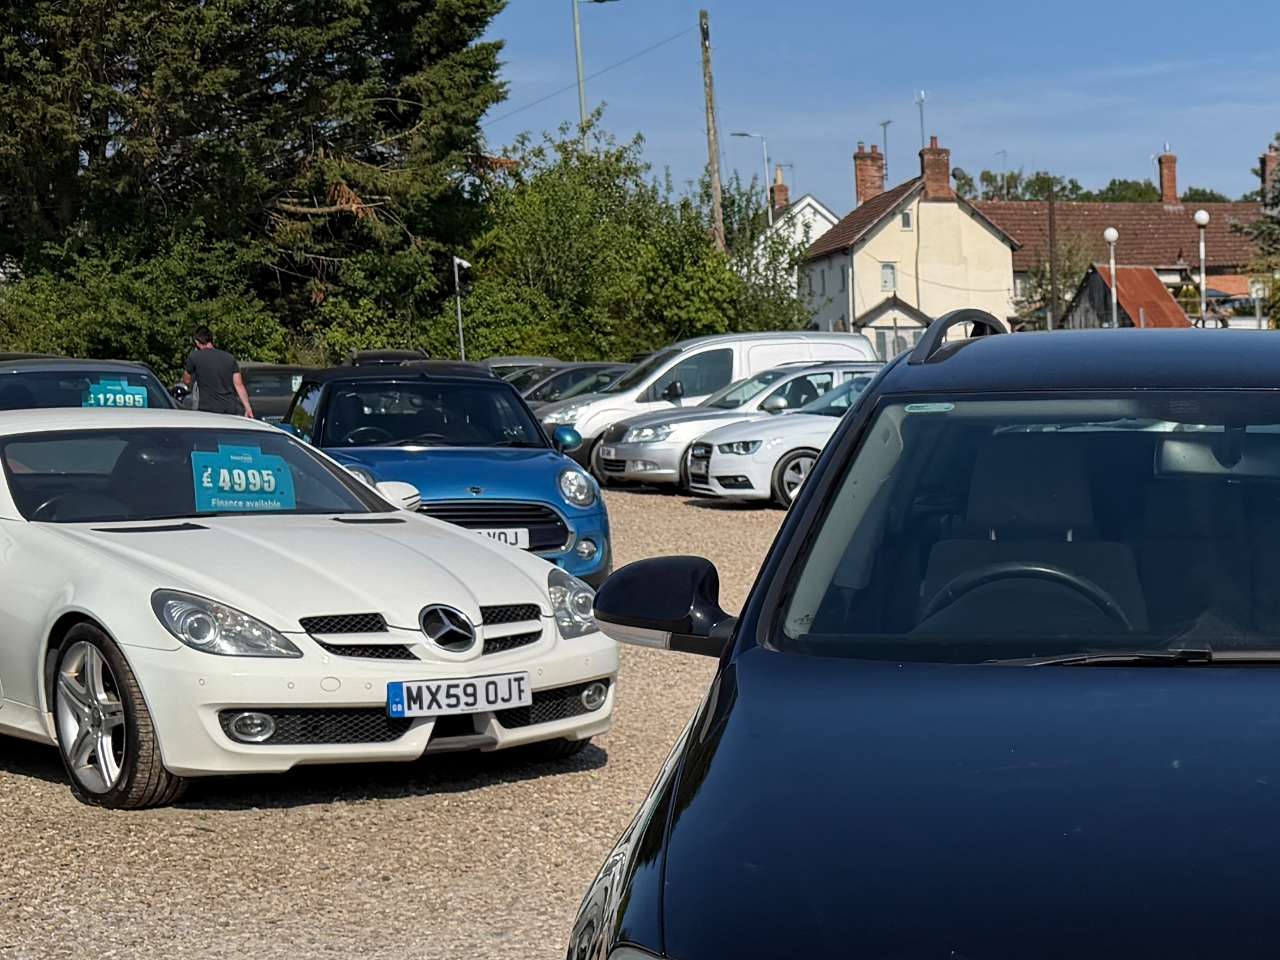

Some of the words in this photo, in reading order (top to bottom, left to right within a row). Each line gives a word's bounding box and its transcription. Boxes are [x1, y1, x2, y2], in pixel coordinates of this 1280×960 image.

[211, 498, 244, 508] Finance
[245, 498, 281, 508] available
[405, 684, 478, 711] MX59
[485, 676, 525, 705] OJT
